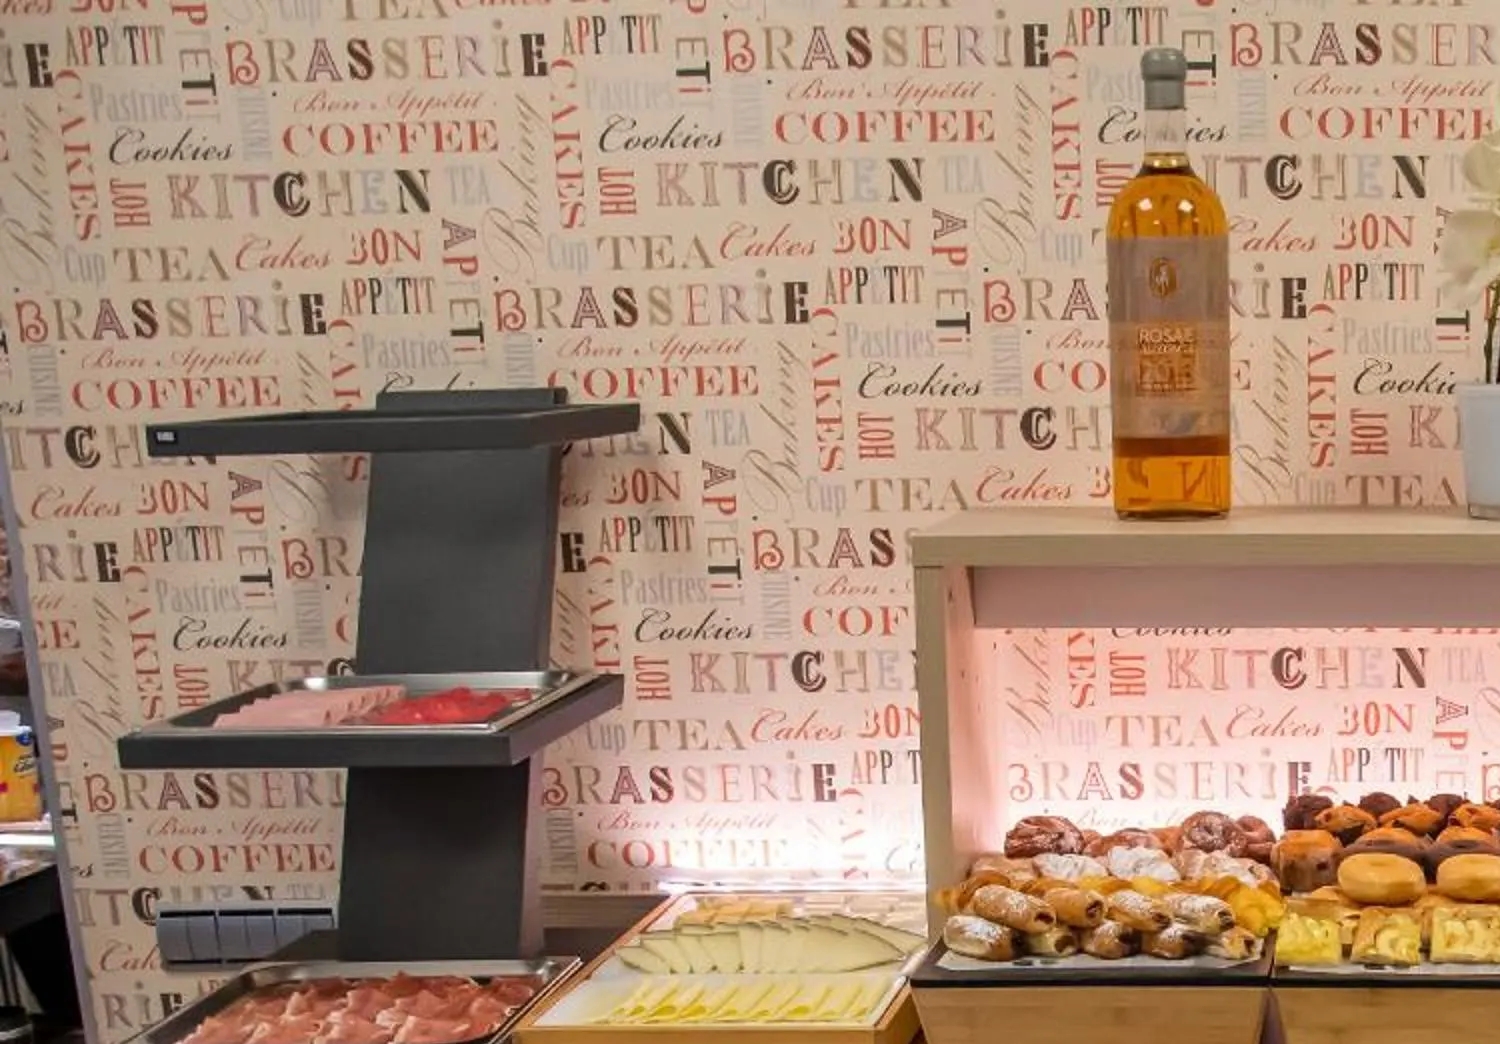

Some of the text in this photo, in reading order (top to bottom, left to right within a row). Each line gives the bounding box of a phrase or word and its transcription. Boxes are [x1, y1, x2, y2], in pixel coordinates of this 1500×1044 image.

[283, 118, 499, 156] COFFEE
[549, 59, 587, 229] CAKES
[597, 113, 725, 153] Cookies
[774, 107, 996, 143] COFFEE
[1050, 49, 1083, 220] CAKES
[56, 71, 99, 239] CAKES
[110, 126, 233, 166] Cookies
[170, 168, 429, 219] KITCHEN
[597, 167, 637, 214] HOT
[657, 158, 922, 206] KITCHEN
[110, 179, 150, 226] HOT
[345, 227, 422, 266] BON
[720, 223, 815, 260] Cakes
[832, 216, 912, 254] BON
[1333, 213, 1415, 251] BON
[113, 247, 228, 283] TEA
[236, 235, 328, 272] Cakes
[596, 236, 714, 271] TEA
[73, 374, 279, 411] COFFEE
[546, 364, 760, 399] COFFEE
[810, 307, 845, 472] CAKES
[858, 362, 984, 400] Cookies
[1307, 303, 1337, 467] CAKES
[704, 409, 753, 448] TEA
[856, 412, 895, 458] HOT
[1350, 409, 1389, 455] HOT
[32, 485, 120, 521] Cakes
[137, 479, 209, 516] BON
[605, 468, 681, 505] BON
[854, 478, 971, 512] TEA
[976, 469, 1071, 504] Cakes
[1344, 474, 1460, 509] TEA
[122, 564, 164, 720] CAKES
[172, 616, 290, 652] Cookies
[634, 607, 756, 643] Cookies
[173, 664, 212, 707] HOT
[633, 656, 672, 700] HOT
[687, 650, 918, 694] KITCHE
[1109, 652, 1147, 696] HOT
[1170, 646, 1426, 690] KITCHEN
[632, 719, 745, 751] TEA
[751, 710, 842, 743] Cakes
[1106, 715, 1220, 747] TEA
[1227, 707, 1319, 740] Cakes
[1336, 701, 1414, 737] BON
[138, 841, 335, 873] COFFEE
